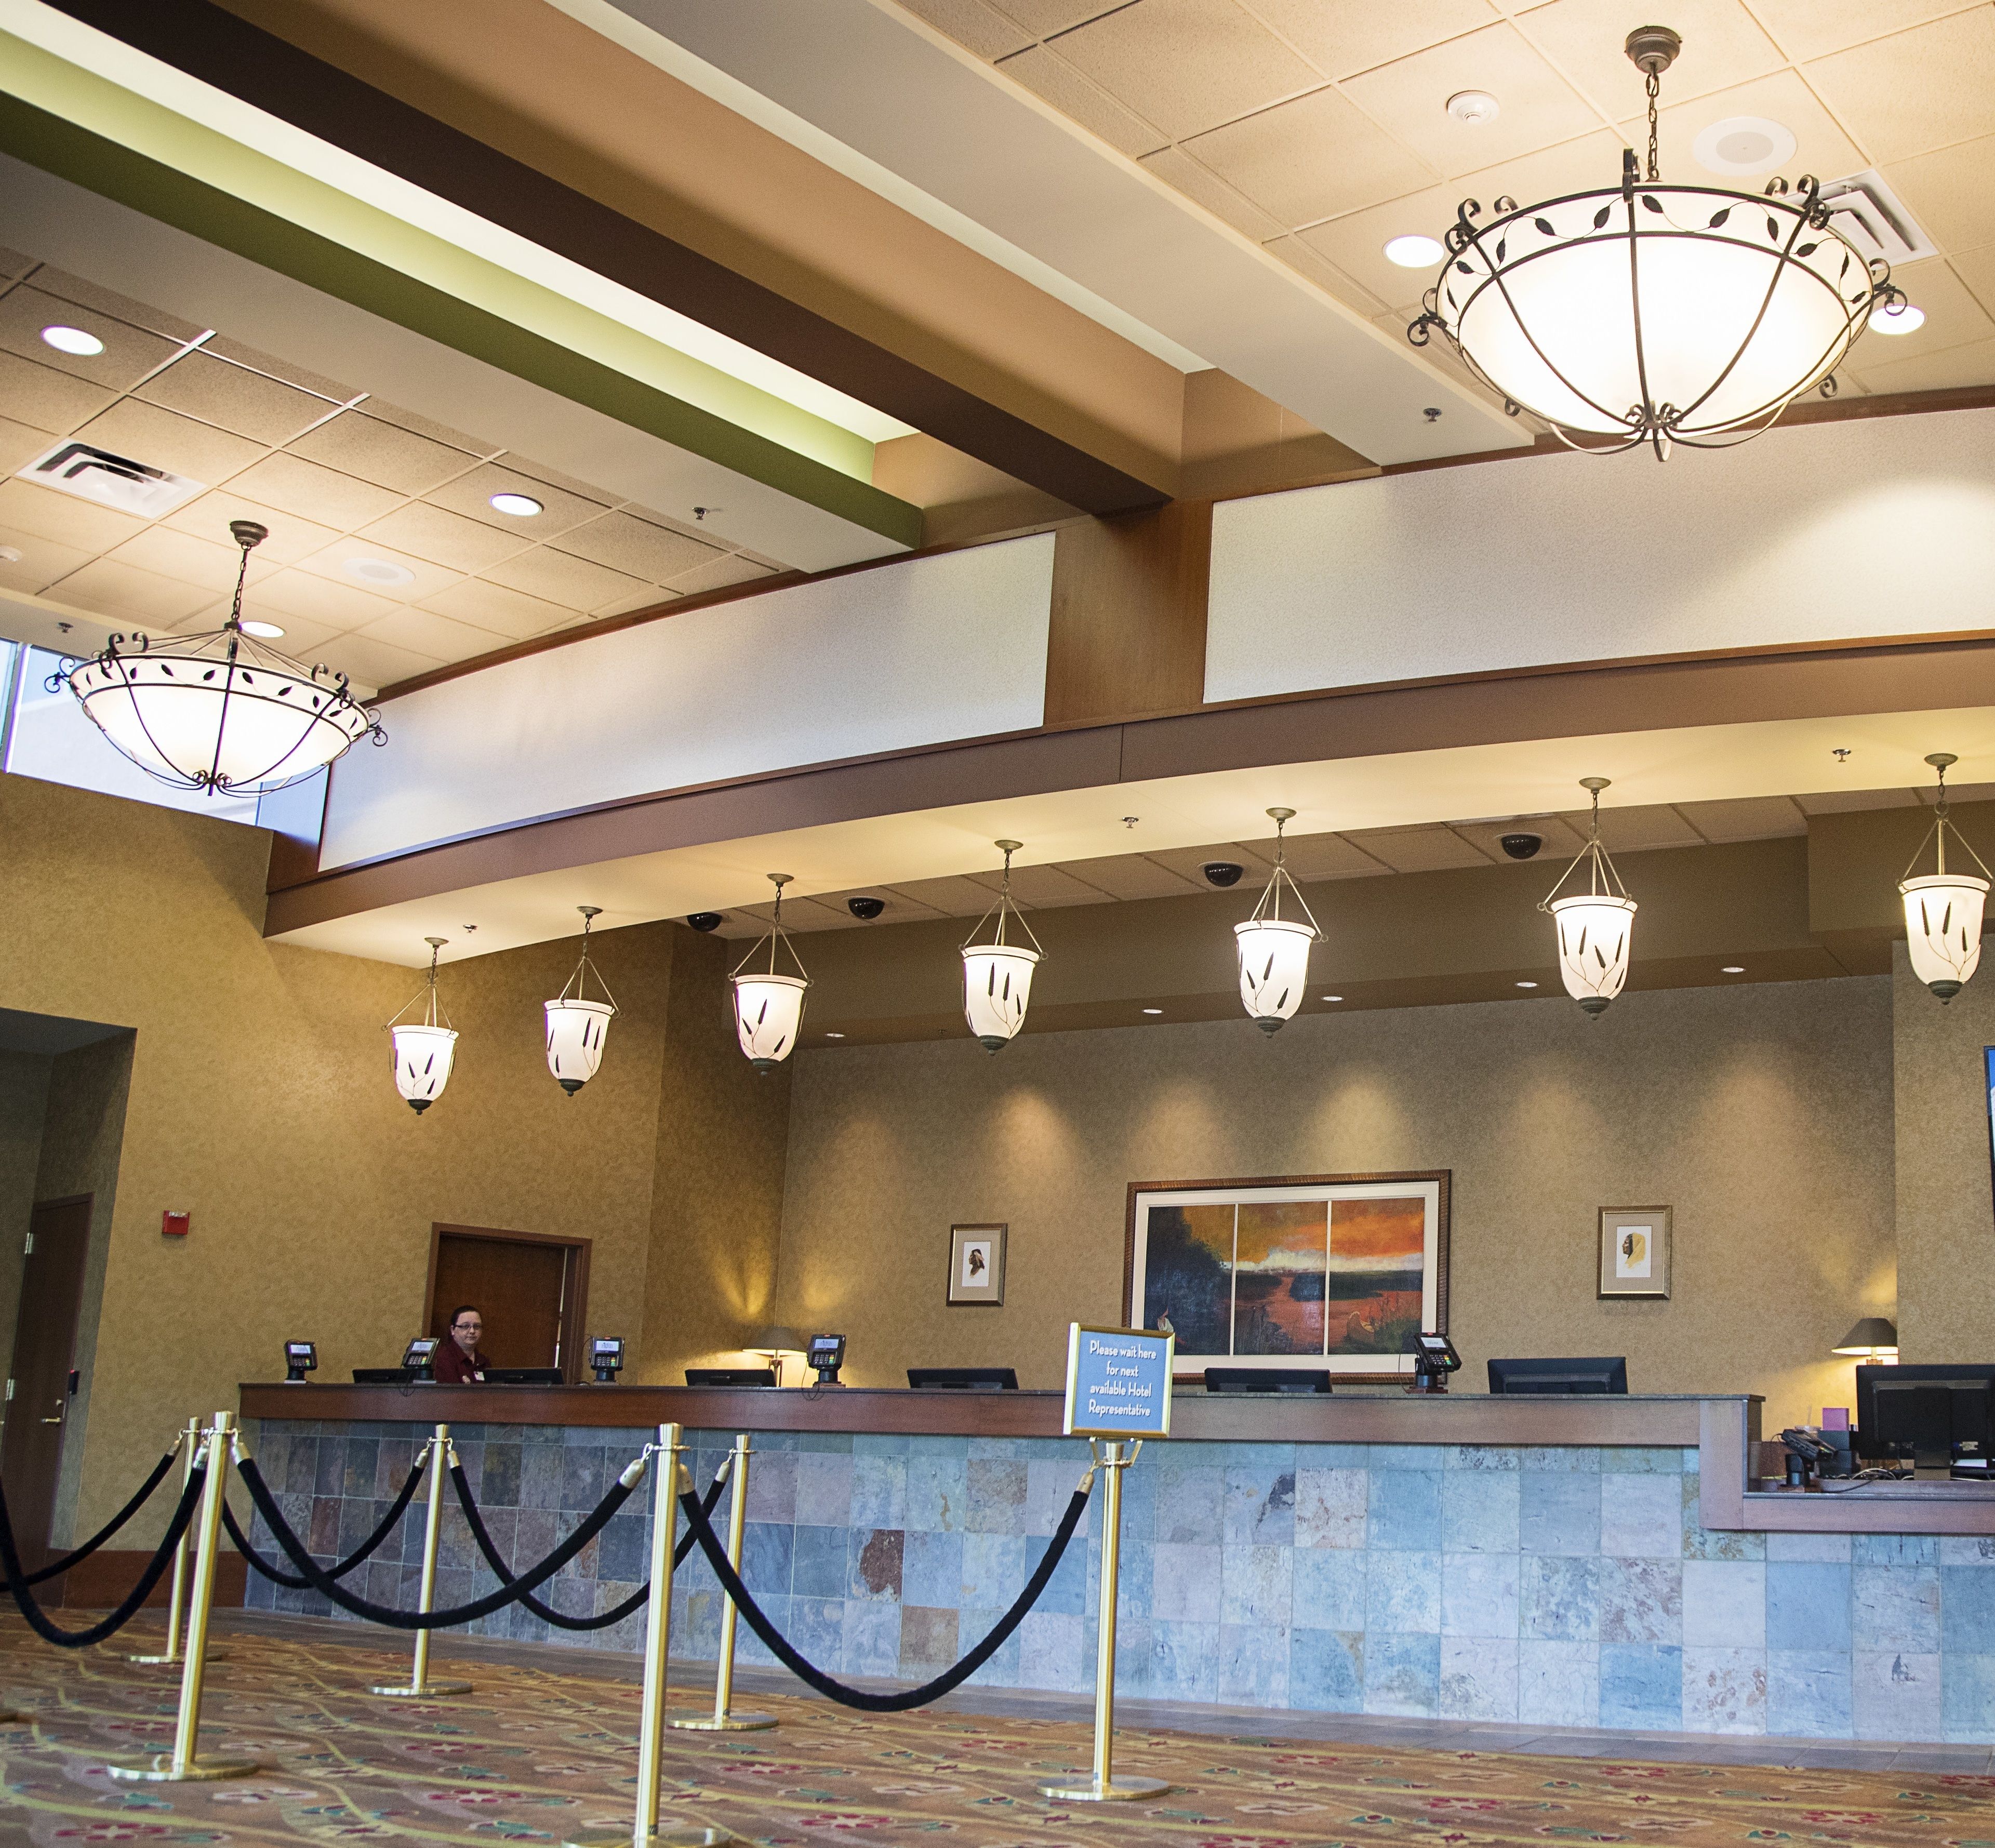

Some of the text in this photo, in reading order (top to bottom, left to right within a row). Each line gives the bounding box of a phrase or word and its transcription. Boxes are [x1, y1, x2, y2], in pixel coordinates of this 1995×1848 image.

[1089, 1340, 1156, 1360] Please wait here
[1107, 1360, 1139, 1377] for next
[1090, 1380, 1152, 1398] available Hotel
[1088, 1398, 1151, 1418] Representative
